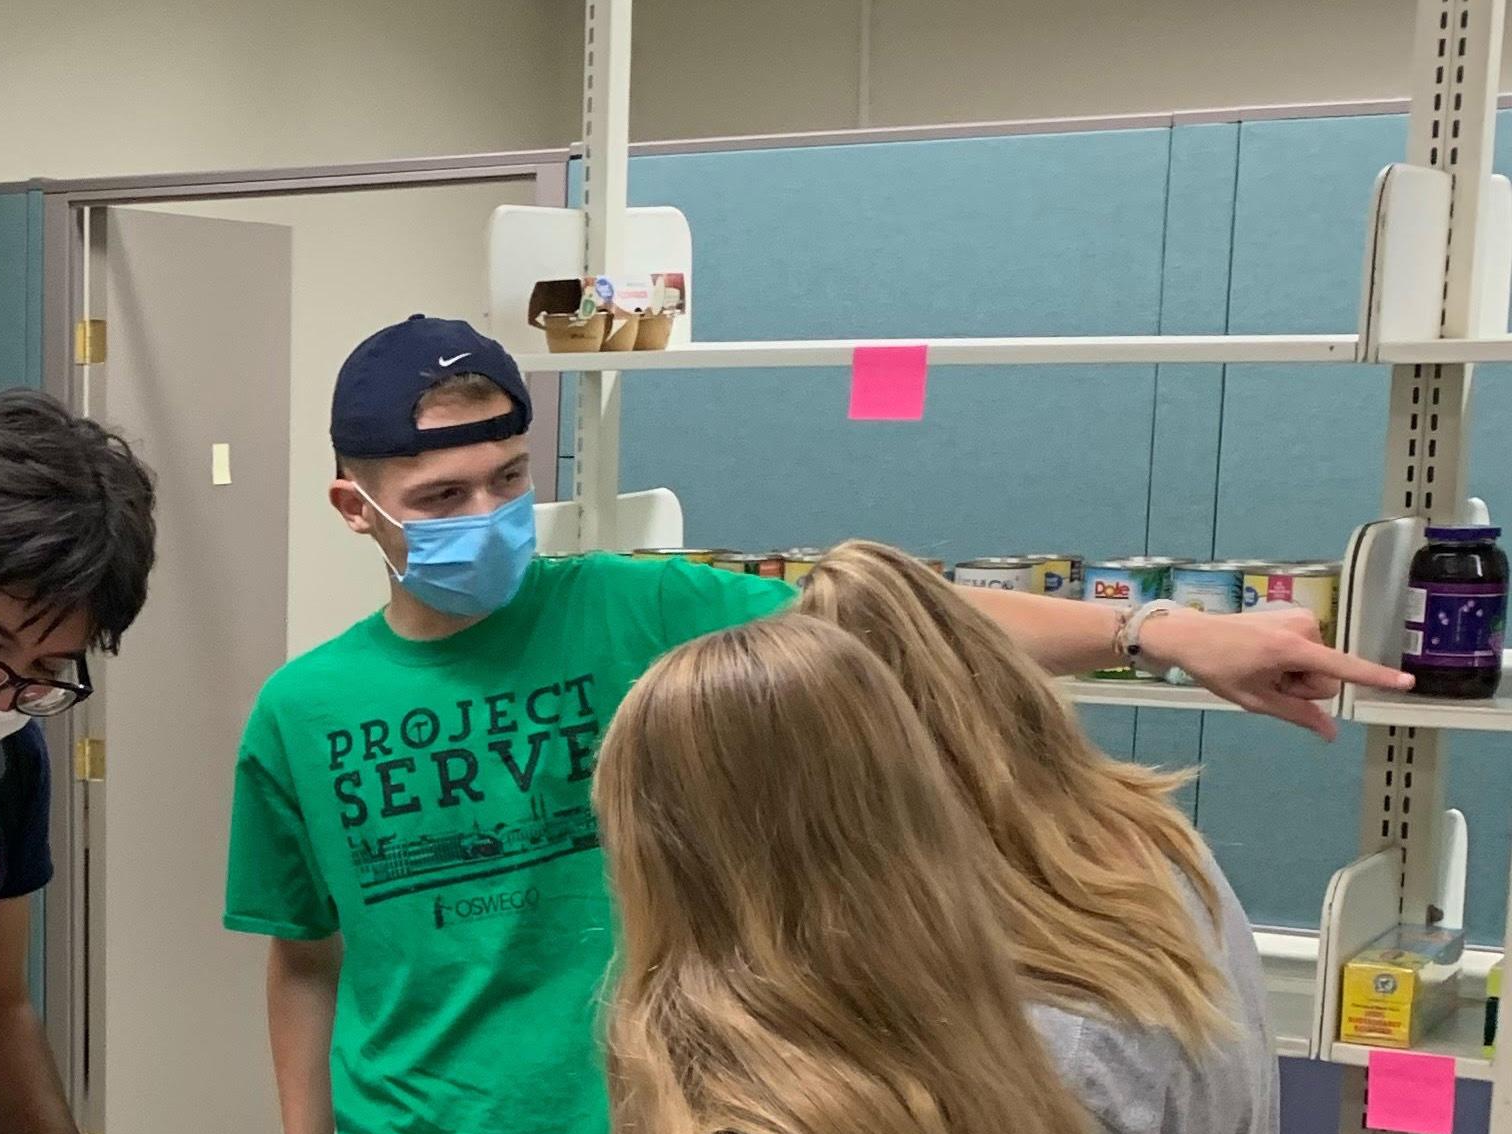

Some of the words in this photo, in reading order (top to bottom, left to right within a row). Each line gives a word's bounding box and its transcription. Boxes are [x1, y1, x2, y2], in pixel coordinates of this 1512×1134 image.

[1095, 580, 1130, 597] Dole
[327, 673, 594, 771] PROJECT
[334, 719, 600, 829] SERVE
[455, 887, 540, 918] OSWEGO
